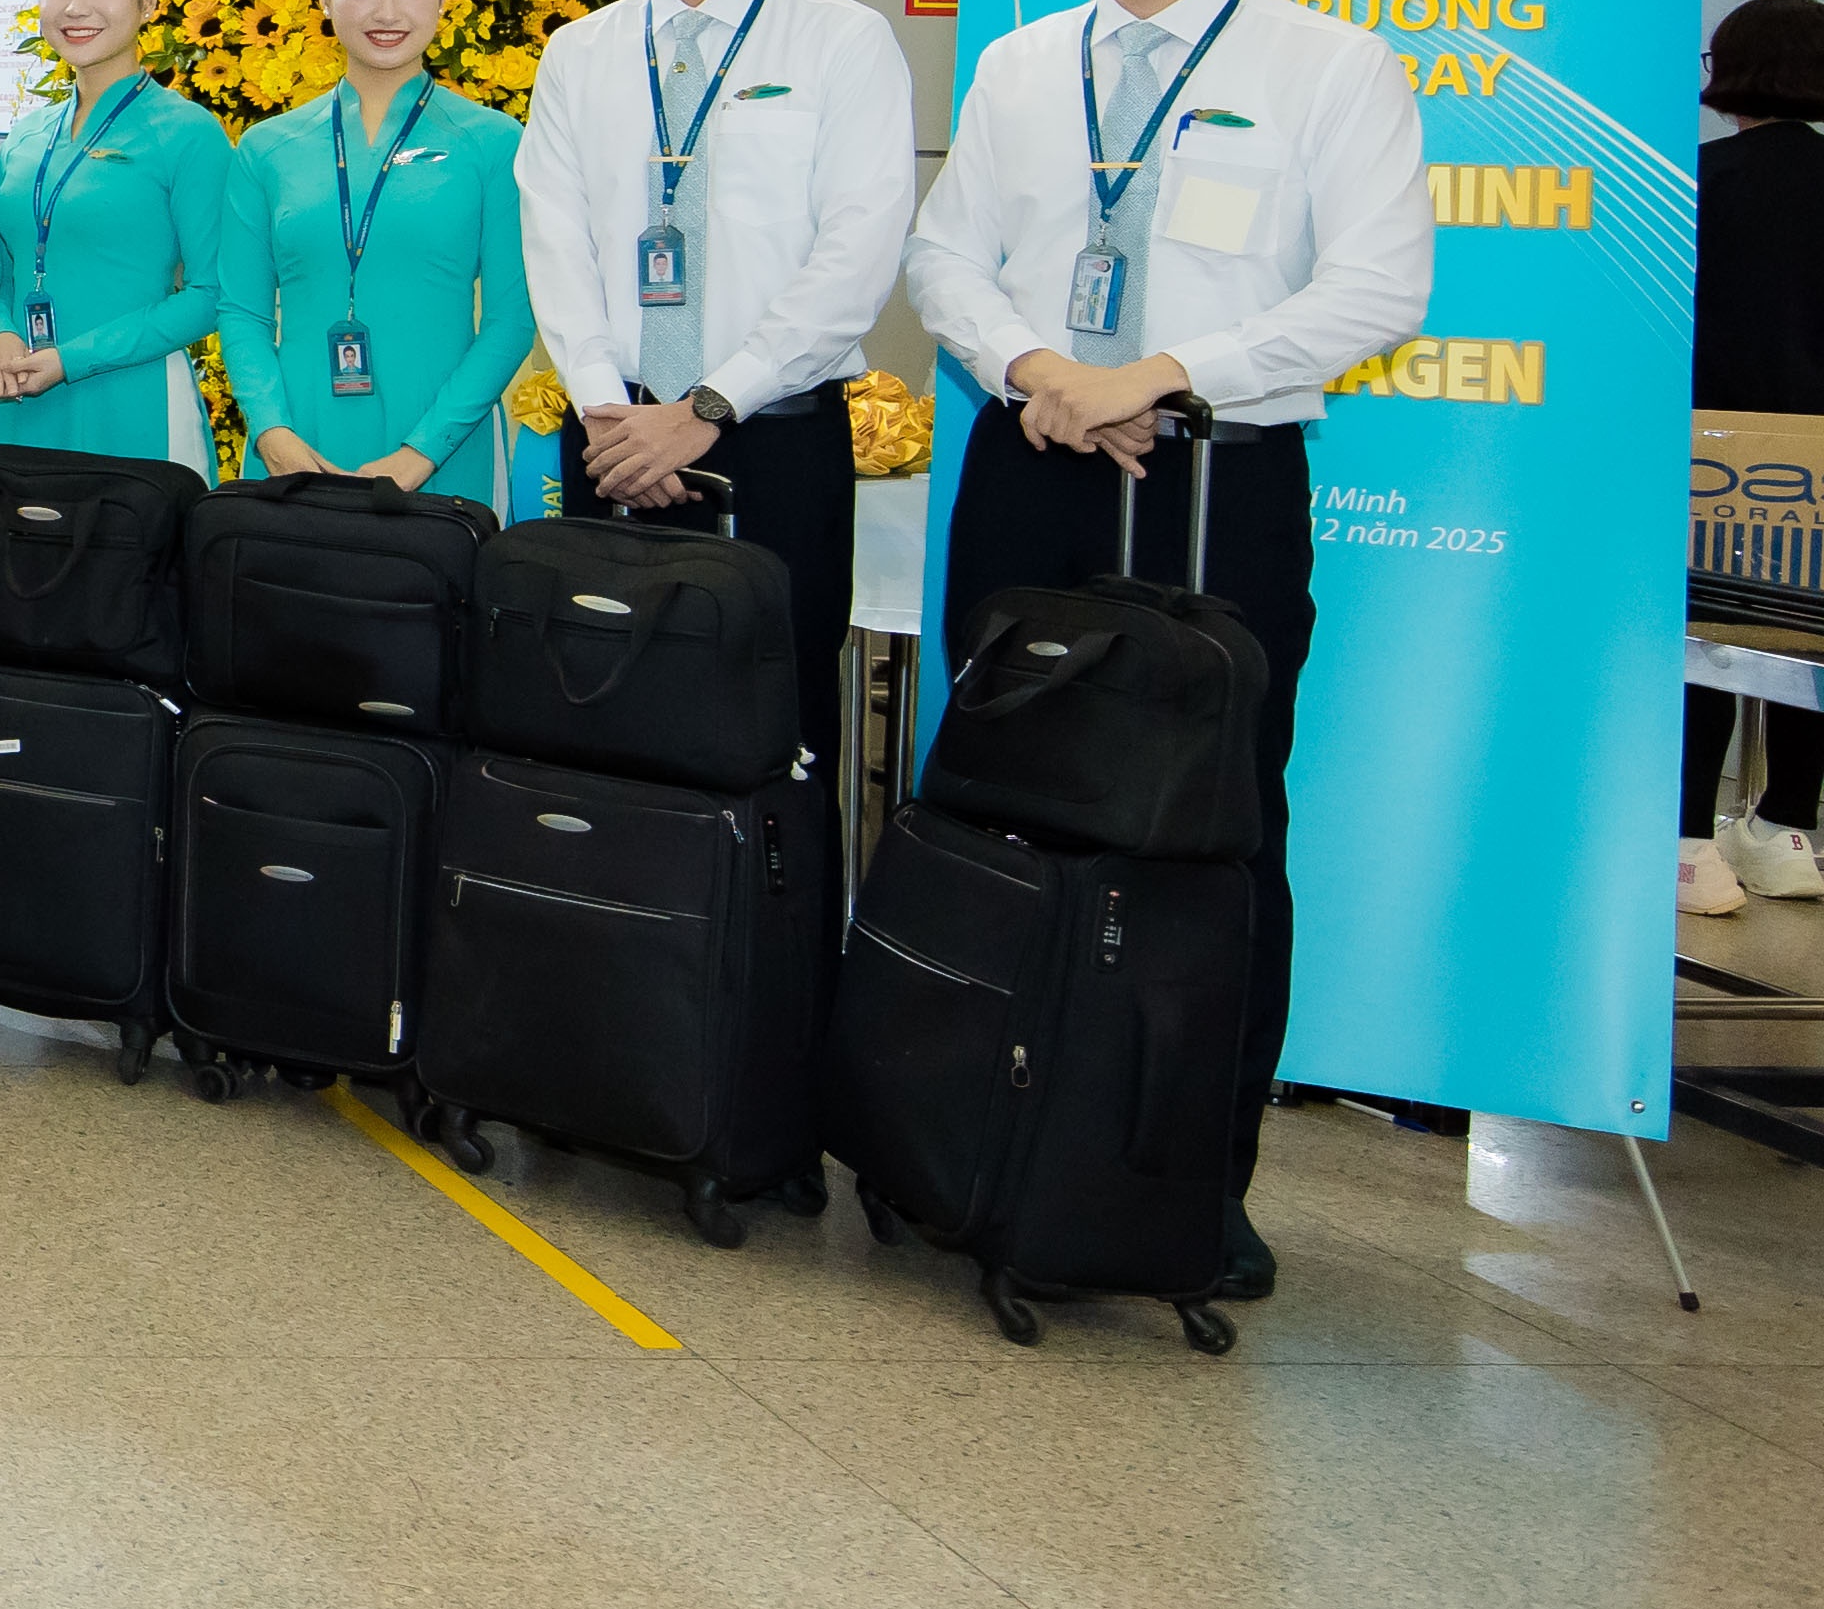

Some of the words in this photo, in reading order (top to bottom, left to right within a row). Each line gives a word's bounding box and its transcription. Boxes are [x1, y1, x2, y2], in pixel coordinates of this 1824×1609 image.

[1325, 486, 1408, 515] Minh
[1346, 520, 1419, 548] năm
[1426, 526, 1507, 554] 2025
